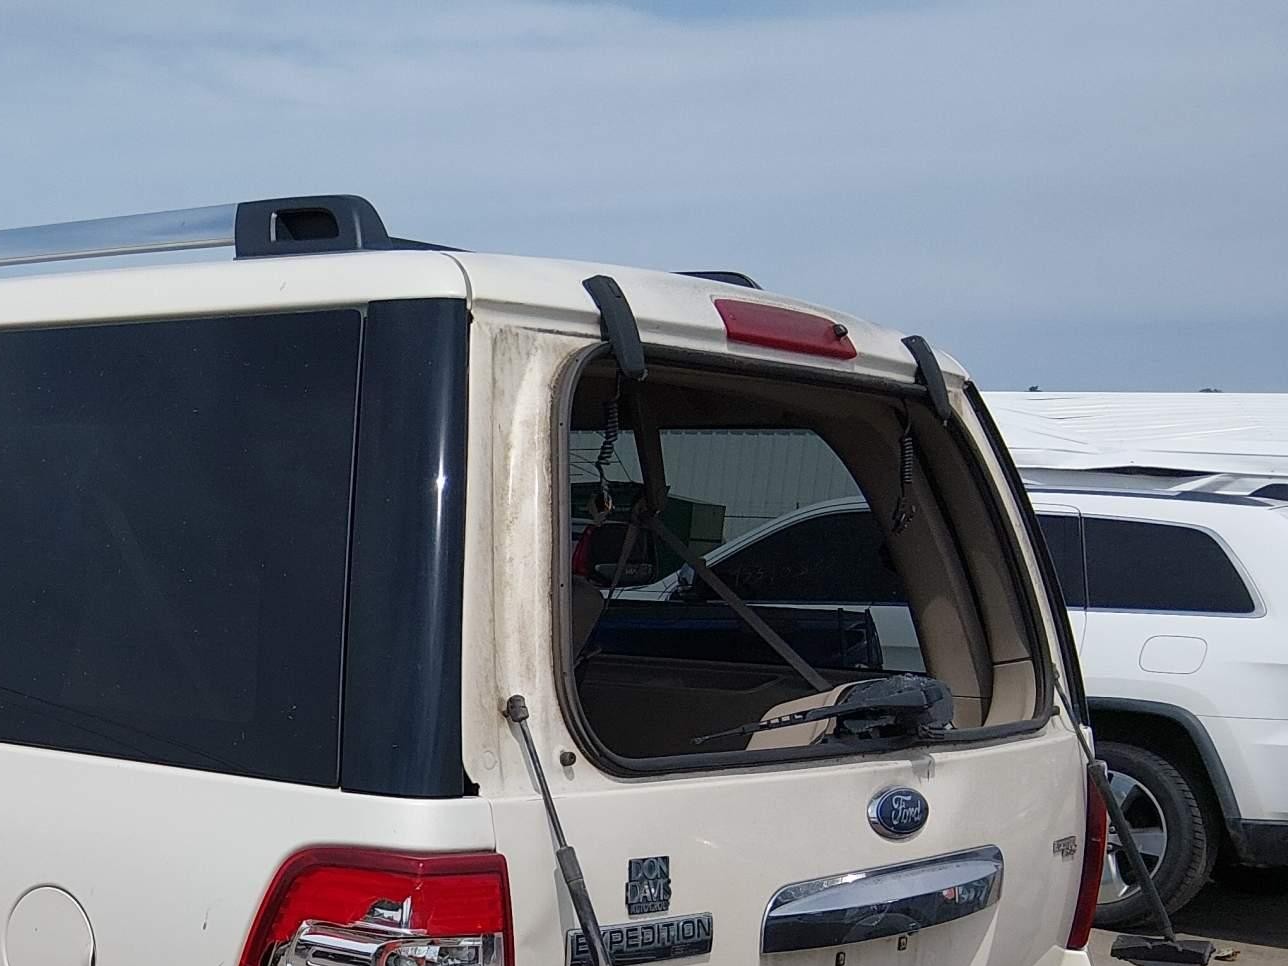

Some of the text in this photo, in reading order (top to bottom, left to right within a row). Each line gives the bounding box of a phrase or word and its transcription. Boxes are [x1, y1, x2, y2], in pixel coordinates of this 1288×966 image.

[892, 795, 921, 825] Ford
[631, 857, 669, 880] DON
[627, 878, 671, 904] DAVIS
[575, 918, 712, 956] EPEDITION
